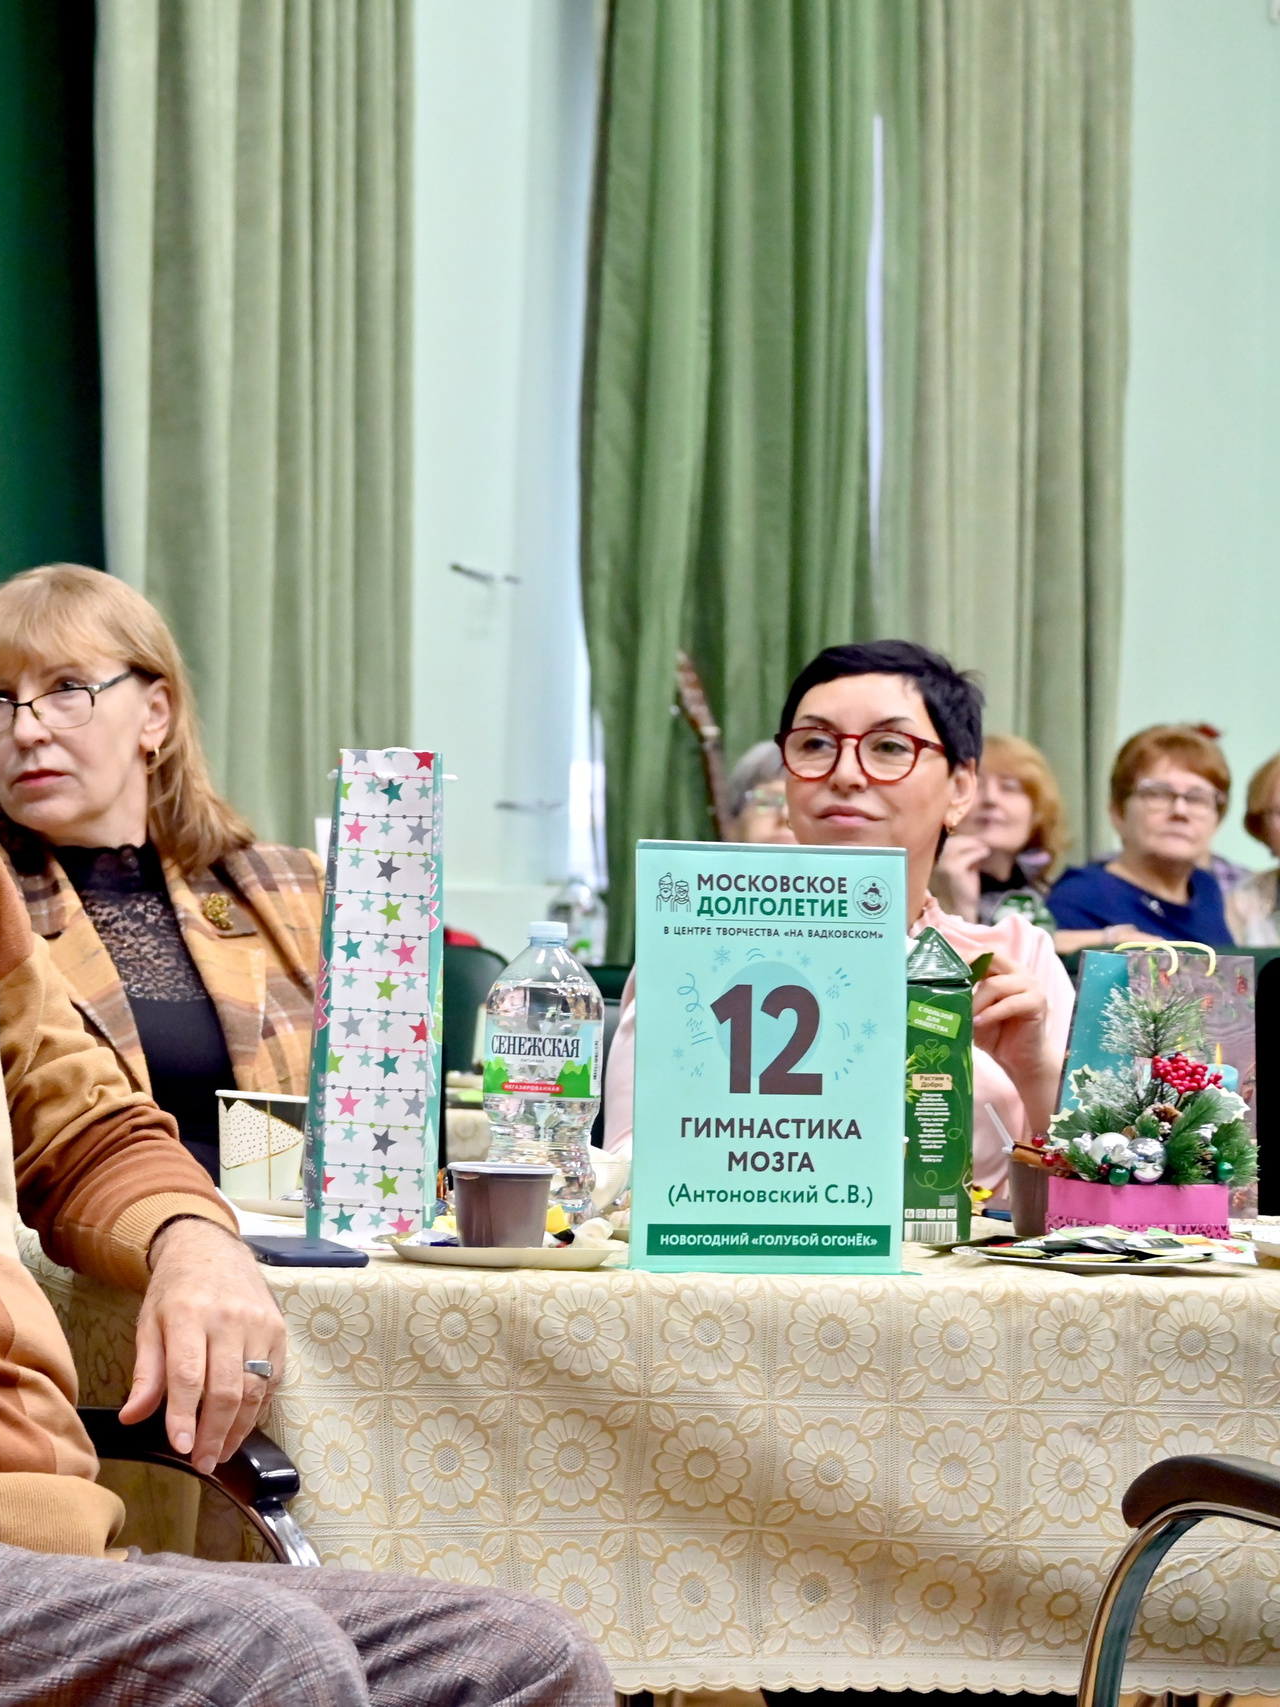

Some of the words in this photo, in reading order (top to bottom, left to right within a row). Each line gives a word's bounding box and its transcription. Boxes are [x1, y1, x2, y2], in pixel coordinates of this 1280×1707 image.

[697, 873, 847, 894] МОСКОВСКОЕ
[697, 896, 848, 917] ДОЛГОЛЕТИЕ
[663, 926, 670, 935] В
[673, 926, 712, 937] ЦЕНТРЕ
[716, 927, 780, 937] ТВОРЧЕСТВА
[783, 929, 804, 938] «НА
[807, 929, 884, 940] ВАДКОВСКОМ»
[491, 1035, 580, 1058] СЕНЕЖСКАЯ
[710, 984, 823, 1095] 12
[680, 1117, 862, 1140] ГИМНАСТИКА
[727, 1151, 815, 1173] МОЗГА
[668, 1183, 818, 1207] (Антоновский
[824, 1184, 873, 1208] С.В.)
[660, 1232, 749, 1247] НОВОГОДНИЙ
[751, 1233, 819, 1247] «ГОЛУБОЙ
[821, 1233, 878, 1247] ОГОНЁК»
